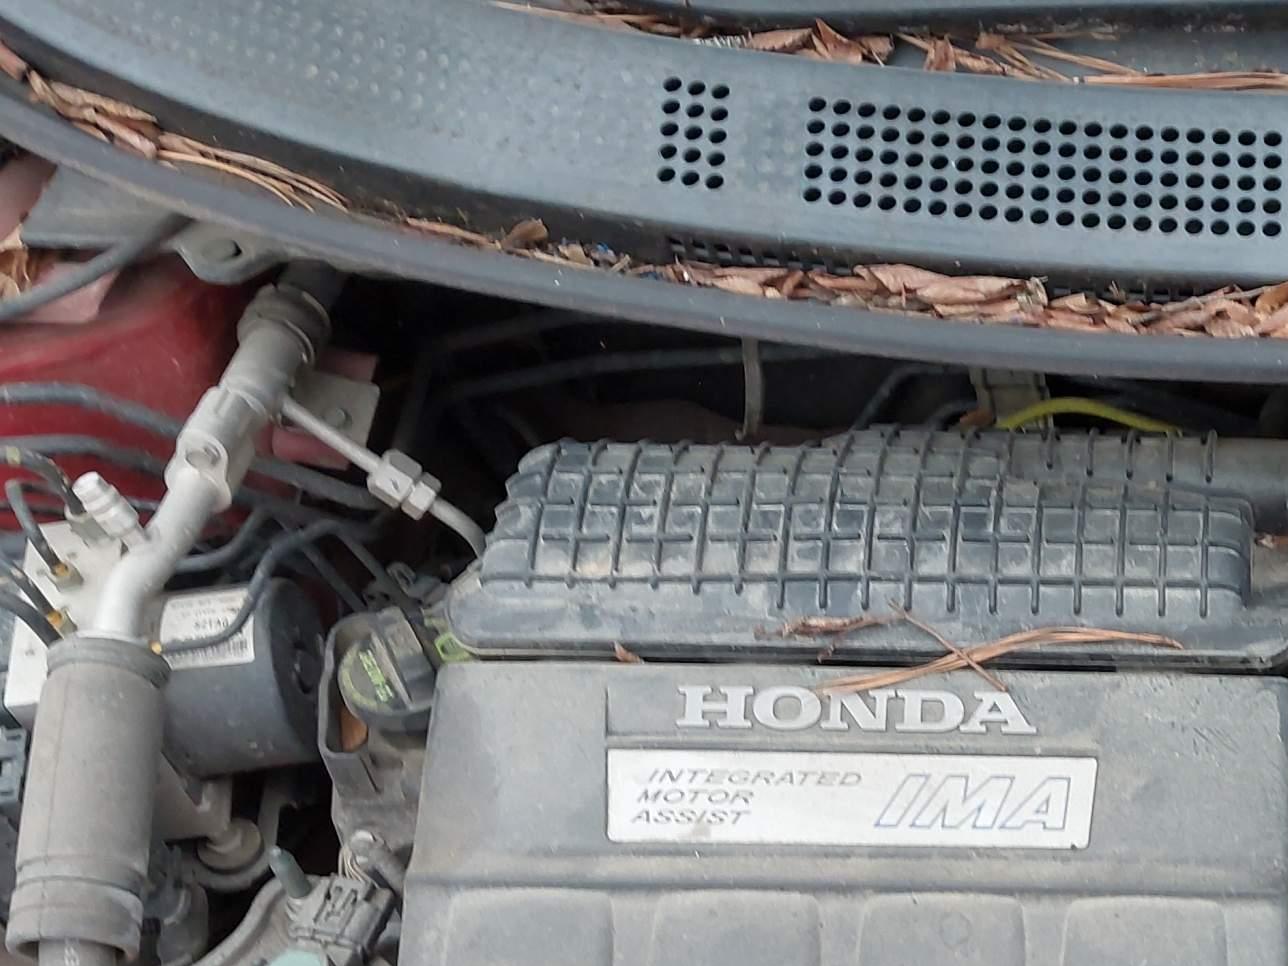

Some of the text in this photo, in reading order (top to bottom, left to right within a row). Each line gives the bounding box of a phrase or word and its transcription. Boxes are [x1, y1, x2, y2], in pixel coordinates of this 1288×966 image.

[676, 685, 1037, 734] HONDA
[648, 769, 862, 787] INTEGRATED
[636, 789, 754, 806] MOTOR
[874, 774, 1072, 831] IMA
[631, 810, 752, 826] ASSIST
